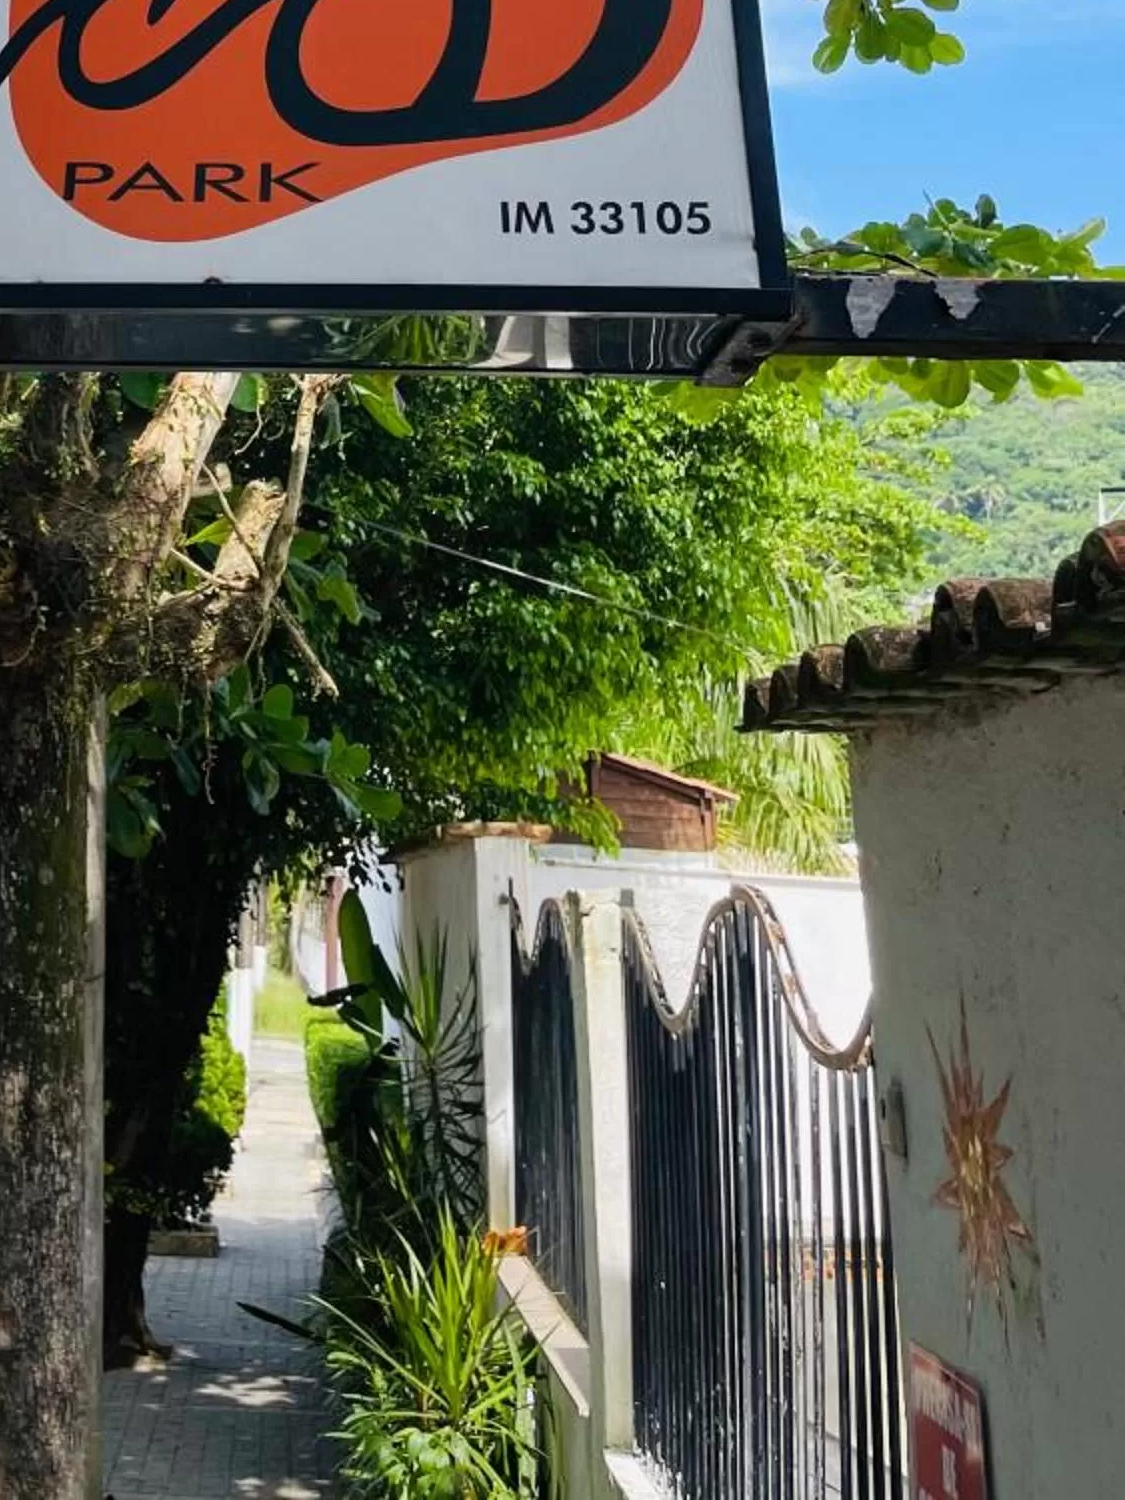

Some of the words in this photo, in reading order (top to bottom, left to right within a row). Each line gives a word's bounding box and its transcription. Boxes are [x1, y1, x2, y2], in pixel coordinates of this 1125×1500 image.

[63, 162, 324, 202] PARK
[500, 201, 554, 235] IM
[570, 201, 712, 235] 33105
